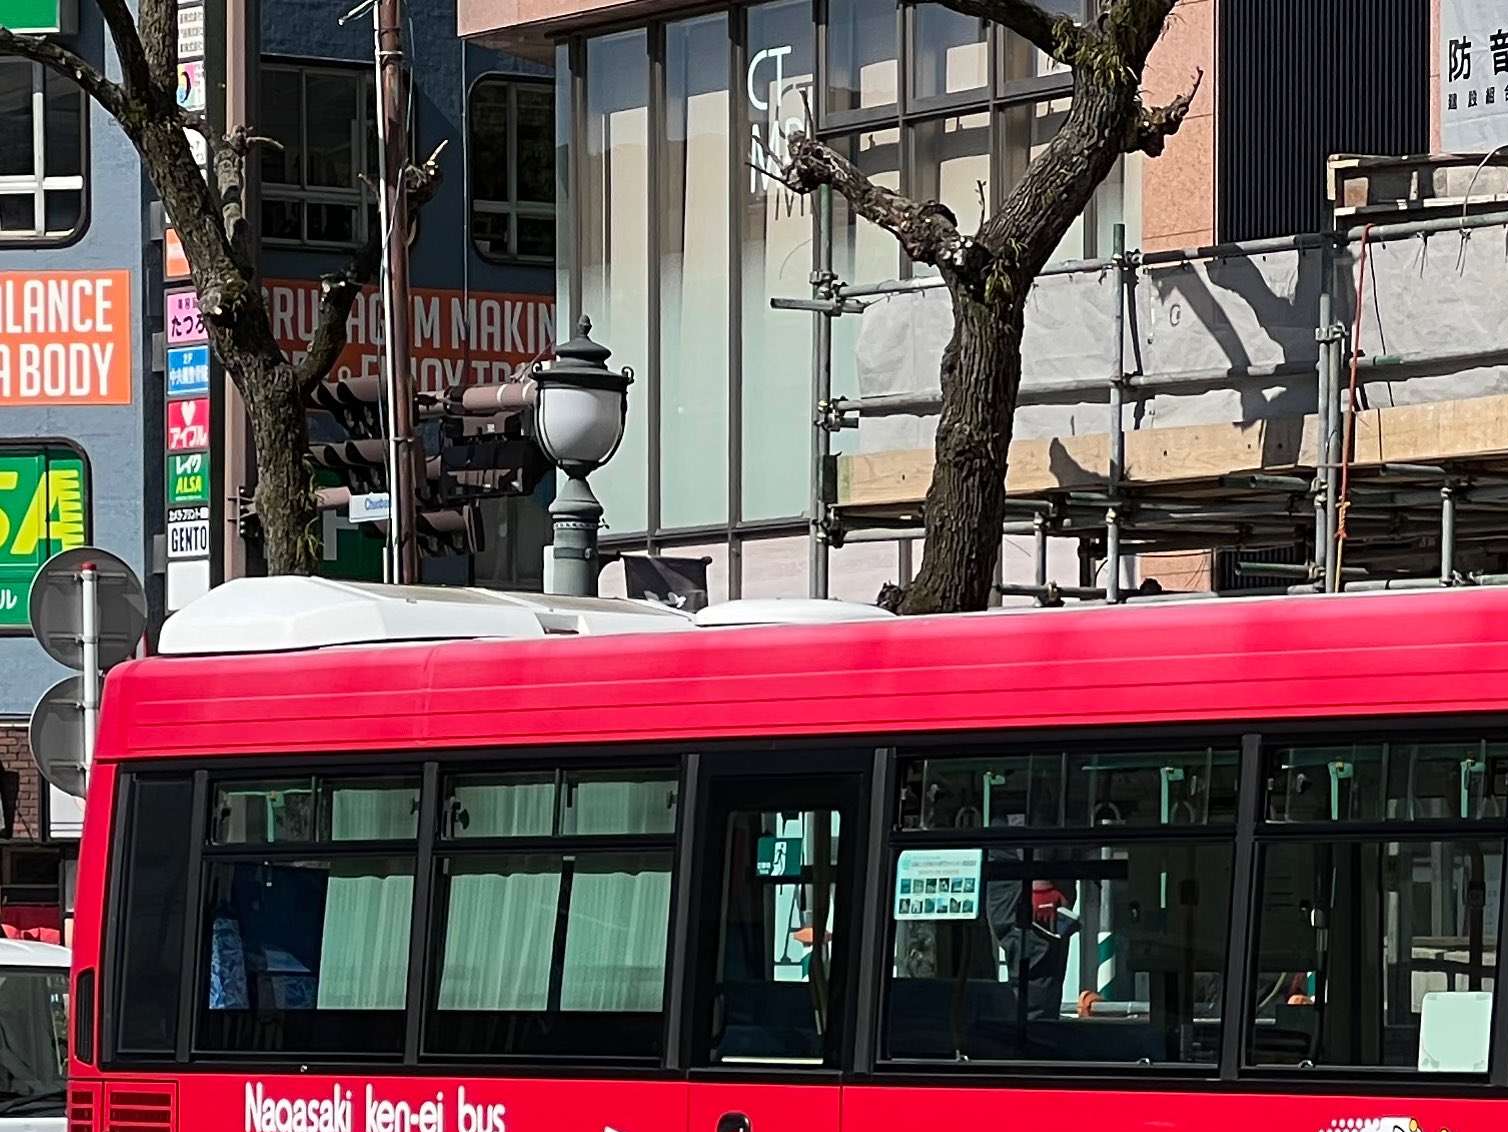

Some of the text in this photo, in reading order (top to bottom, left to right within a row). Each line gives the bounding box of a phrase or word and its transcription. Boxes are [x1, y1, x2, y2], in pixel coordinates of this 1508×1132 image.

[0, 278, 113, 334] LANCE
[20, 342, 115, 397] BODY
[170, 425, 208, 450] アイフル
[176, 454, 202, 475] レイク
[176, 475, 202, 494] ALSA
